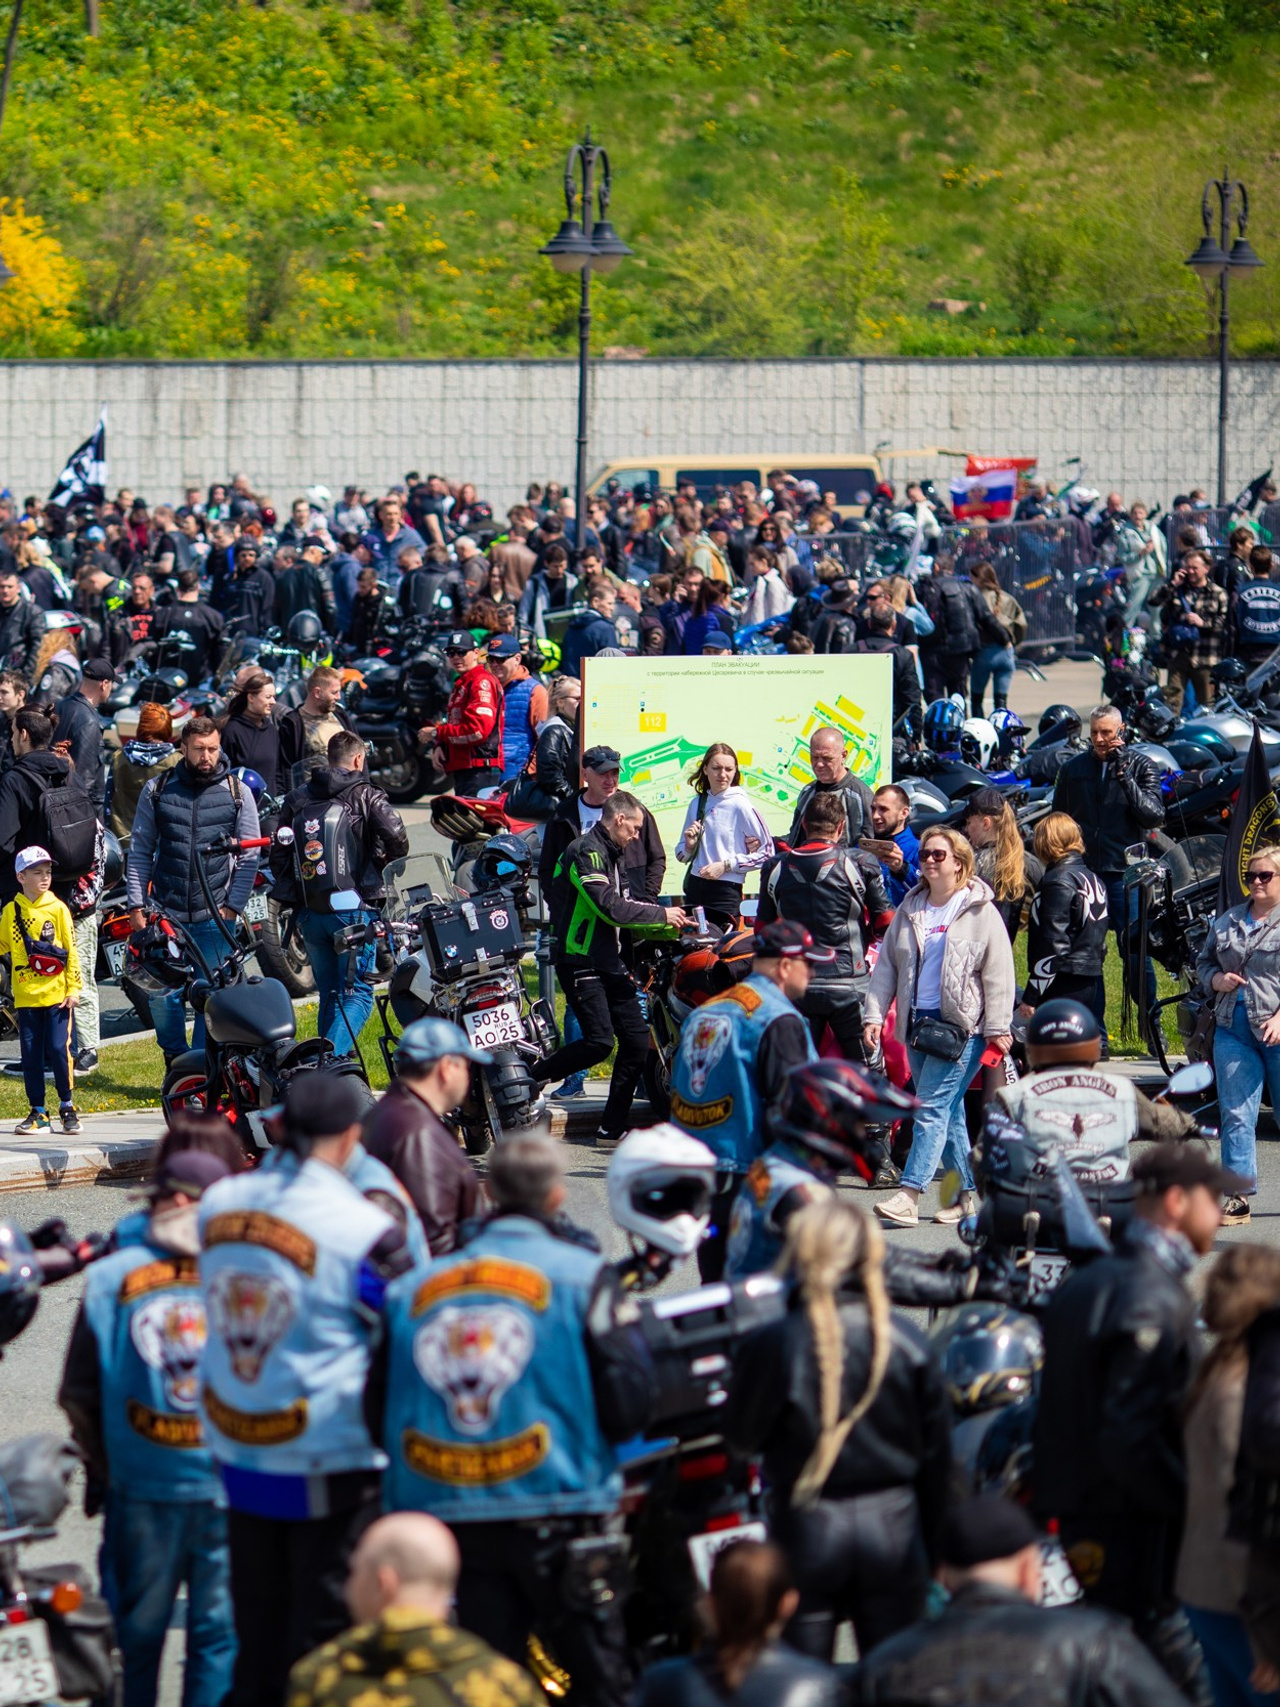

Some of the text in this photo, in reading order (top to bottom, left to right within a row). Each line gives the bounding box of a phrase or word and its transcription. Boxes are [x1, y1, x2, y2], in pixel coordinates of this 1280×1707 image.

[644, 715, 661, 727] 112
[1245, 798, 1275, 845] DRAGONS
[253, 910, 265, 920] 25
[472, 1008, 510, 1028] 5036
[474, 1025, 519, 1048] AO 25
[1033, 1074, 1116, 1098] IRON ANGELS
